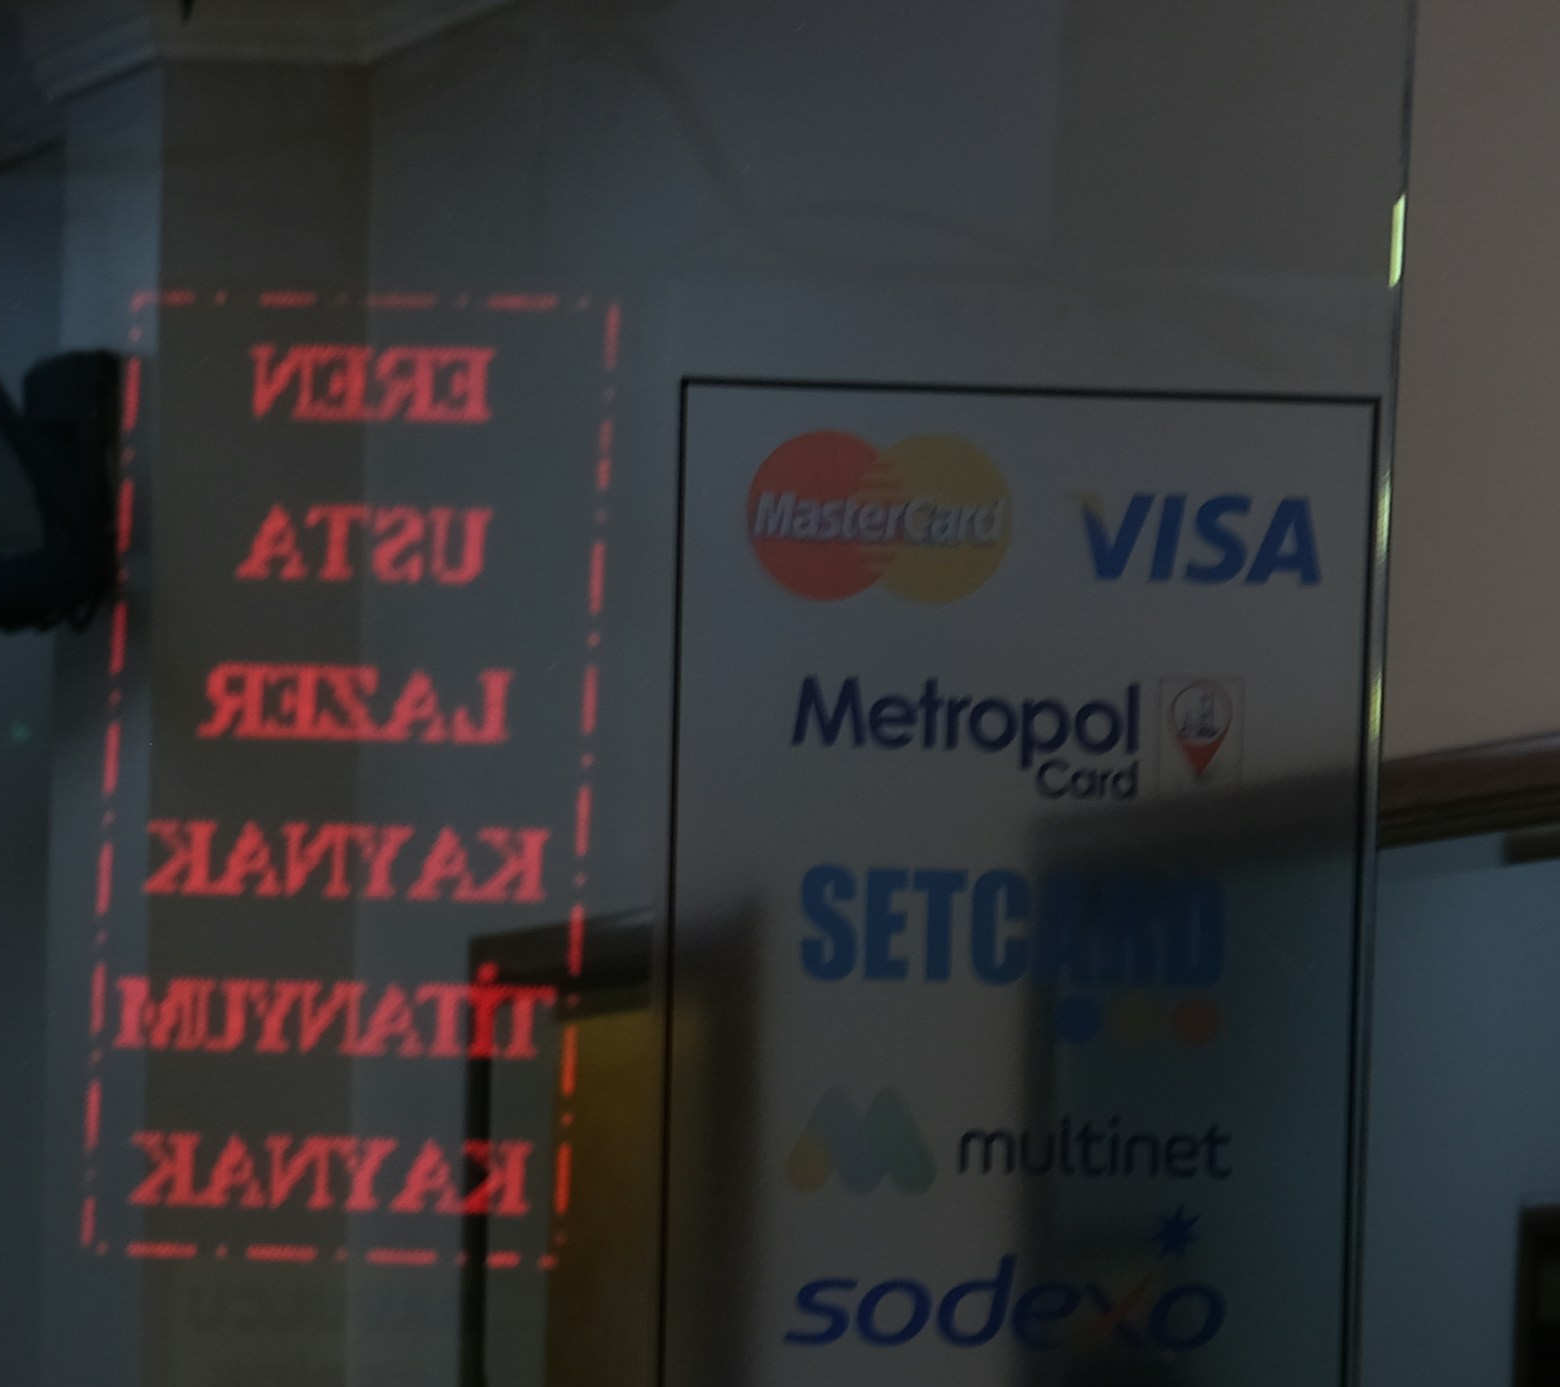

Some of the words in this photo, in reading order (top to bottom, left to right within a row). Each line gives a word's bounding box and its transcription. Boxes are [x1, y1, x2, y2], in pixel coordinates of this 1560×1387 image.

[752, 490, 1004, 550] MasterCard
[1078, 492, 1322, 588] VISA
[790, 674, 1141, 769] Metropol
[1035, 757, 1140, 800] Card
[800, 860, 1227, 989] SETCARD
[956, 1115, 1233, 1180] multinet
[781, 1252, 1227, 1353] sodexo
